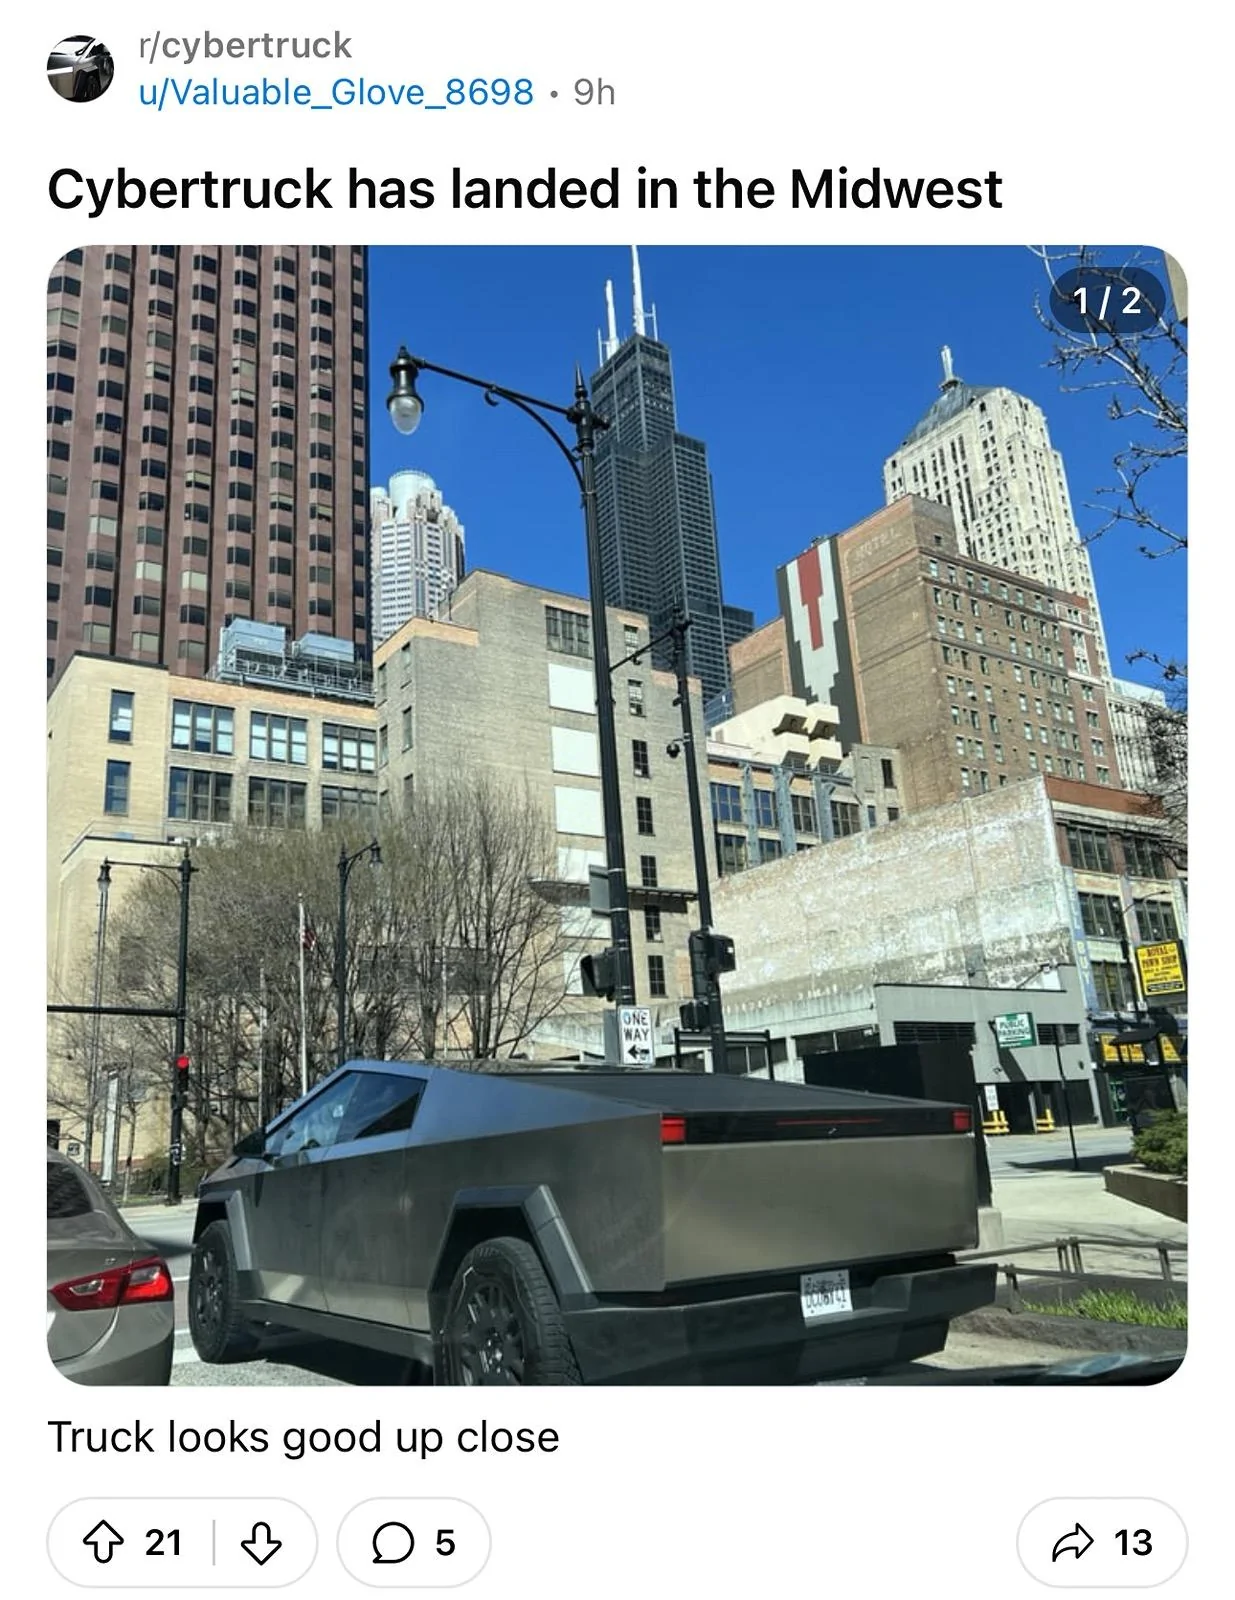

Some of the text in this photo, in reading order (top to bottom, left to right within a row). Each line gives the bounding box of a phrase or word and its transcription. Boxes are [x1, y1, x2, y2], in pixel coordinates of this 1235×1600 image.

[623, 1011, 649, 1026] ONE
[999, 1019, 1025, 1030] PUBLIC
[623, 1028, 649, 1042] WAY
[998, 1026, 1030, 1037] PARKING
